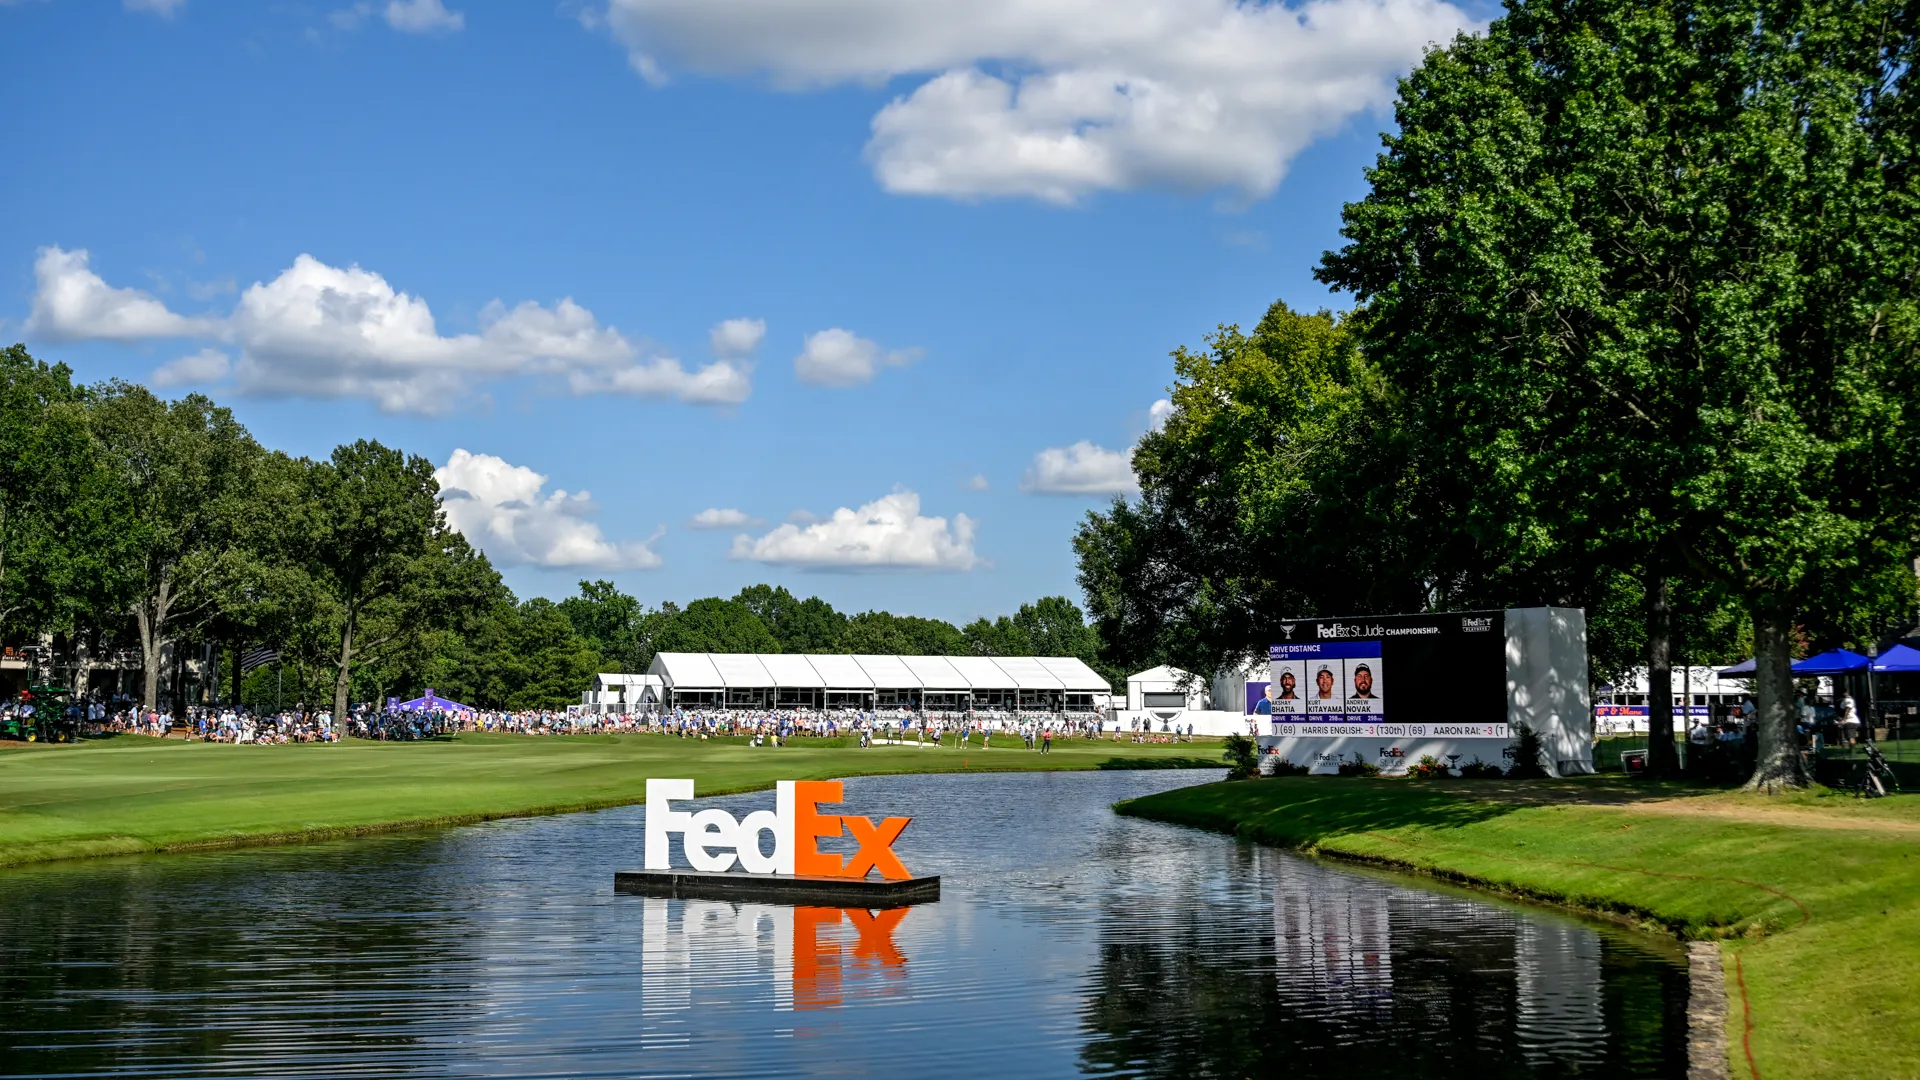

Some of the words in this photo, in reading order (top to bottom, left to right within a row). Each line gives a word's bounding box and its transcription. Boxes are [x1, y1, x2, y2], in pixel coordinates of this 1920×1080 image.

[1317, 623, 1350, 638] FedEx
[1363, 624, 1384, 637] Jude
[1386, 627, 1439, 636] CHAMPIONSHIP
[1289, 645, 1321, 653] DISTANCE
[1281, 725, 1296, 735] (69)
[1302, 726, 1329, 735] HARRIS
[1331, 726, 1363, 735] ENGLISH:
[1365, 726, 1374, 735] -3
[1376, 724, 1406, 736] (T30th)
[1409, 724, 1426, 736] (69)
[1433, 726, 1463, 735] AARON
[1465, 726, 1481, 735] RAI:
[1483, 726, 1493, 735] -3
[1257, 744, 1279, 755] FedEx
[1380, 748, 1405, 757] FedEx
[645, 779, 912, 880] FedEx
